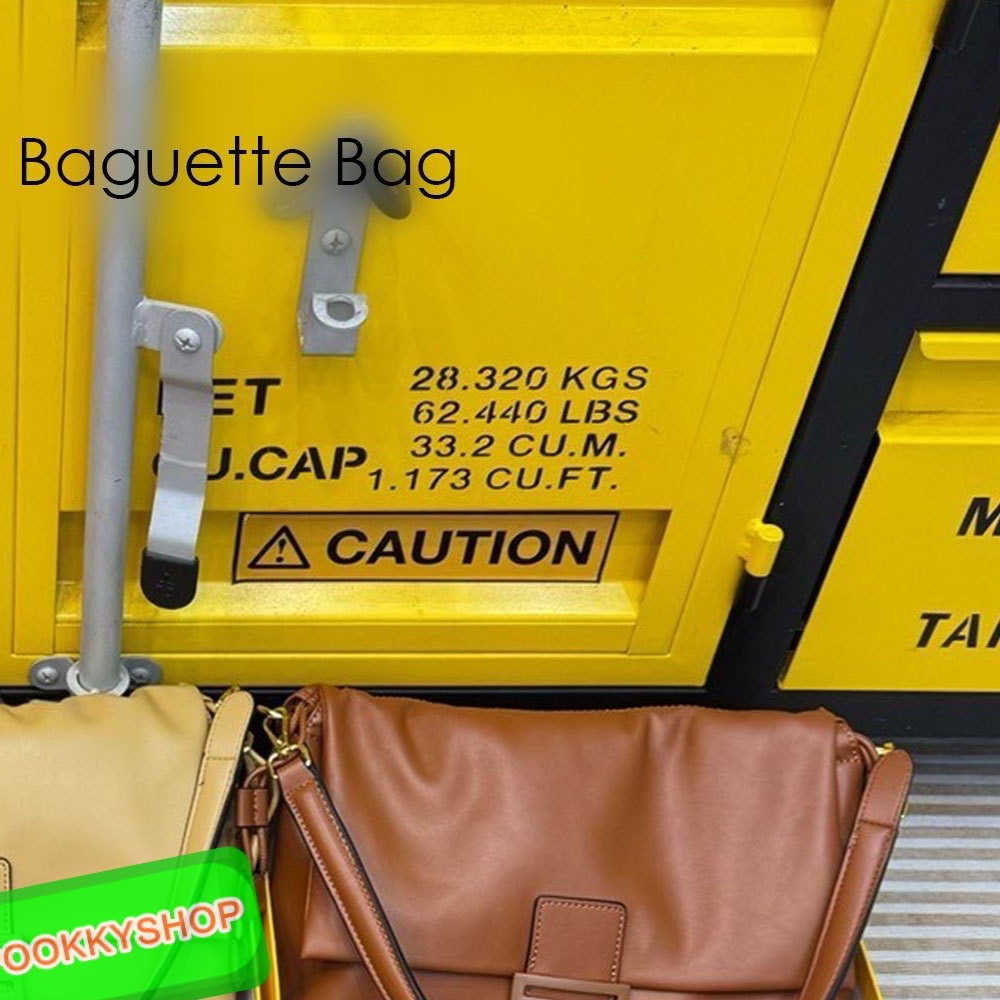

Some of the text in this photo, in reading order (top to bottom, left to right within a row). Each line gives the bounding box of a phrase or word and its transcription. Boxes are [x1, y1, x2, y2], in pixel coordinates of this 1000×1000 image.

[409, 366, 650, 391] 28.320 KGS
[156, 377, 281, 416] ET
[412, 400, 641, 425] 62.440 LBS
[410, 433, 628, 458] 33.2 CU.M.
[368, 467, 619, 491] 1.173 CU.FT.
[326, 530, 597, 566] CAUTION
